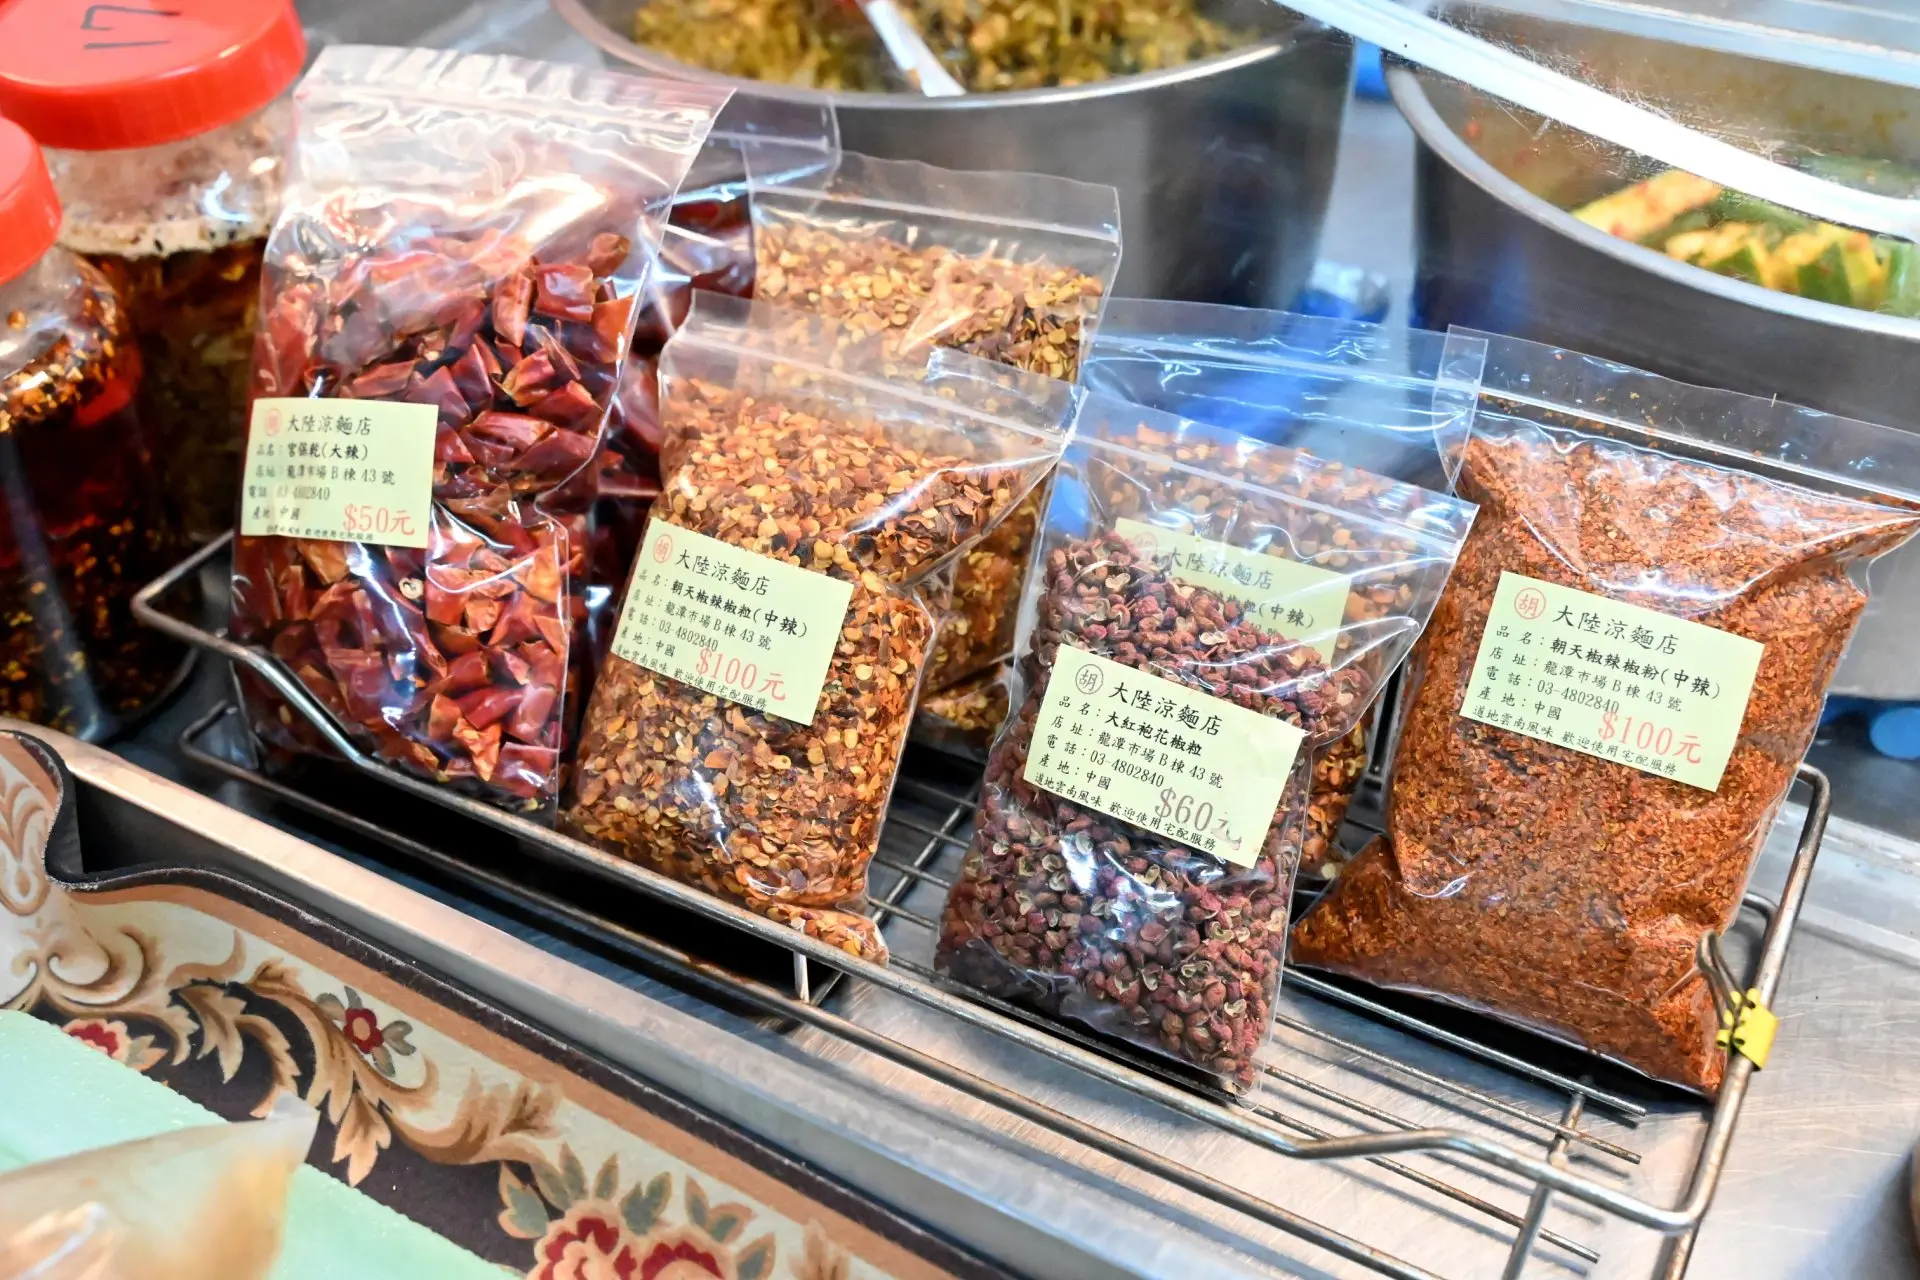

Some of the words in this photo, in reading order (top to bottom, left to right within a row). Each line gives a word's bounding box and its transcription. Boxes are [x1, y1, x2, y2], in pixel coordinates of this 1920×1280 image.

[287, 415, 373, 436] 大陸涼麵店
[343, 503, 416, 536] $50元
[675, 548, 770, 596] 大陸涼麵店
[1168, 547, 1274, 590] 大陸涼麵店
[1516, 590, 1543, 618] 胡
[1552, 604, 1680, 656] 大陸涼麵店
[695, 646, 787, 702] $100元
[1077, 666, 1100, 693] 胡
[1109, 682, 1223, 736] 大陸涼麵店
[1473, 705, 1554, 738] 道地雲南風味
[1560, 732, 1677, 776] 歡迎使用宅配服務
[1597, 710, 1702, 765] $100元
[1034, 772, 1102, 808] 道地雲南風味
[1108, 801, 1217, 850] 歡迎使用宅配服務
